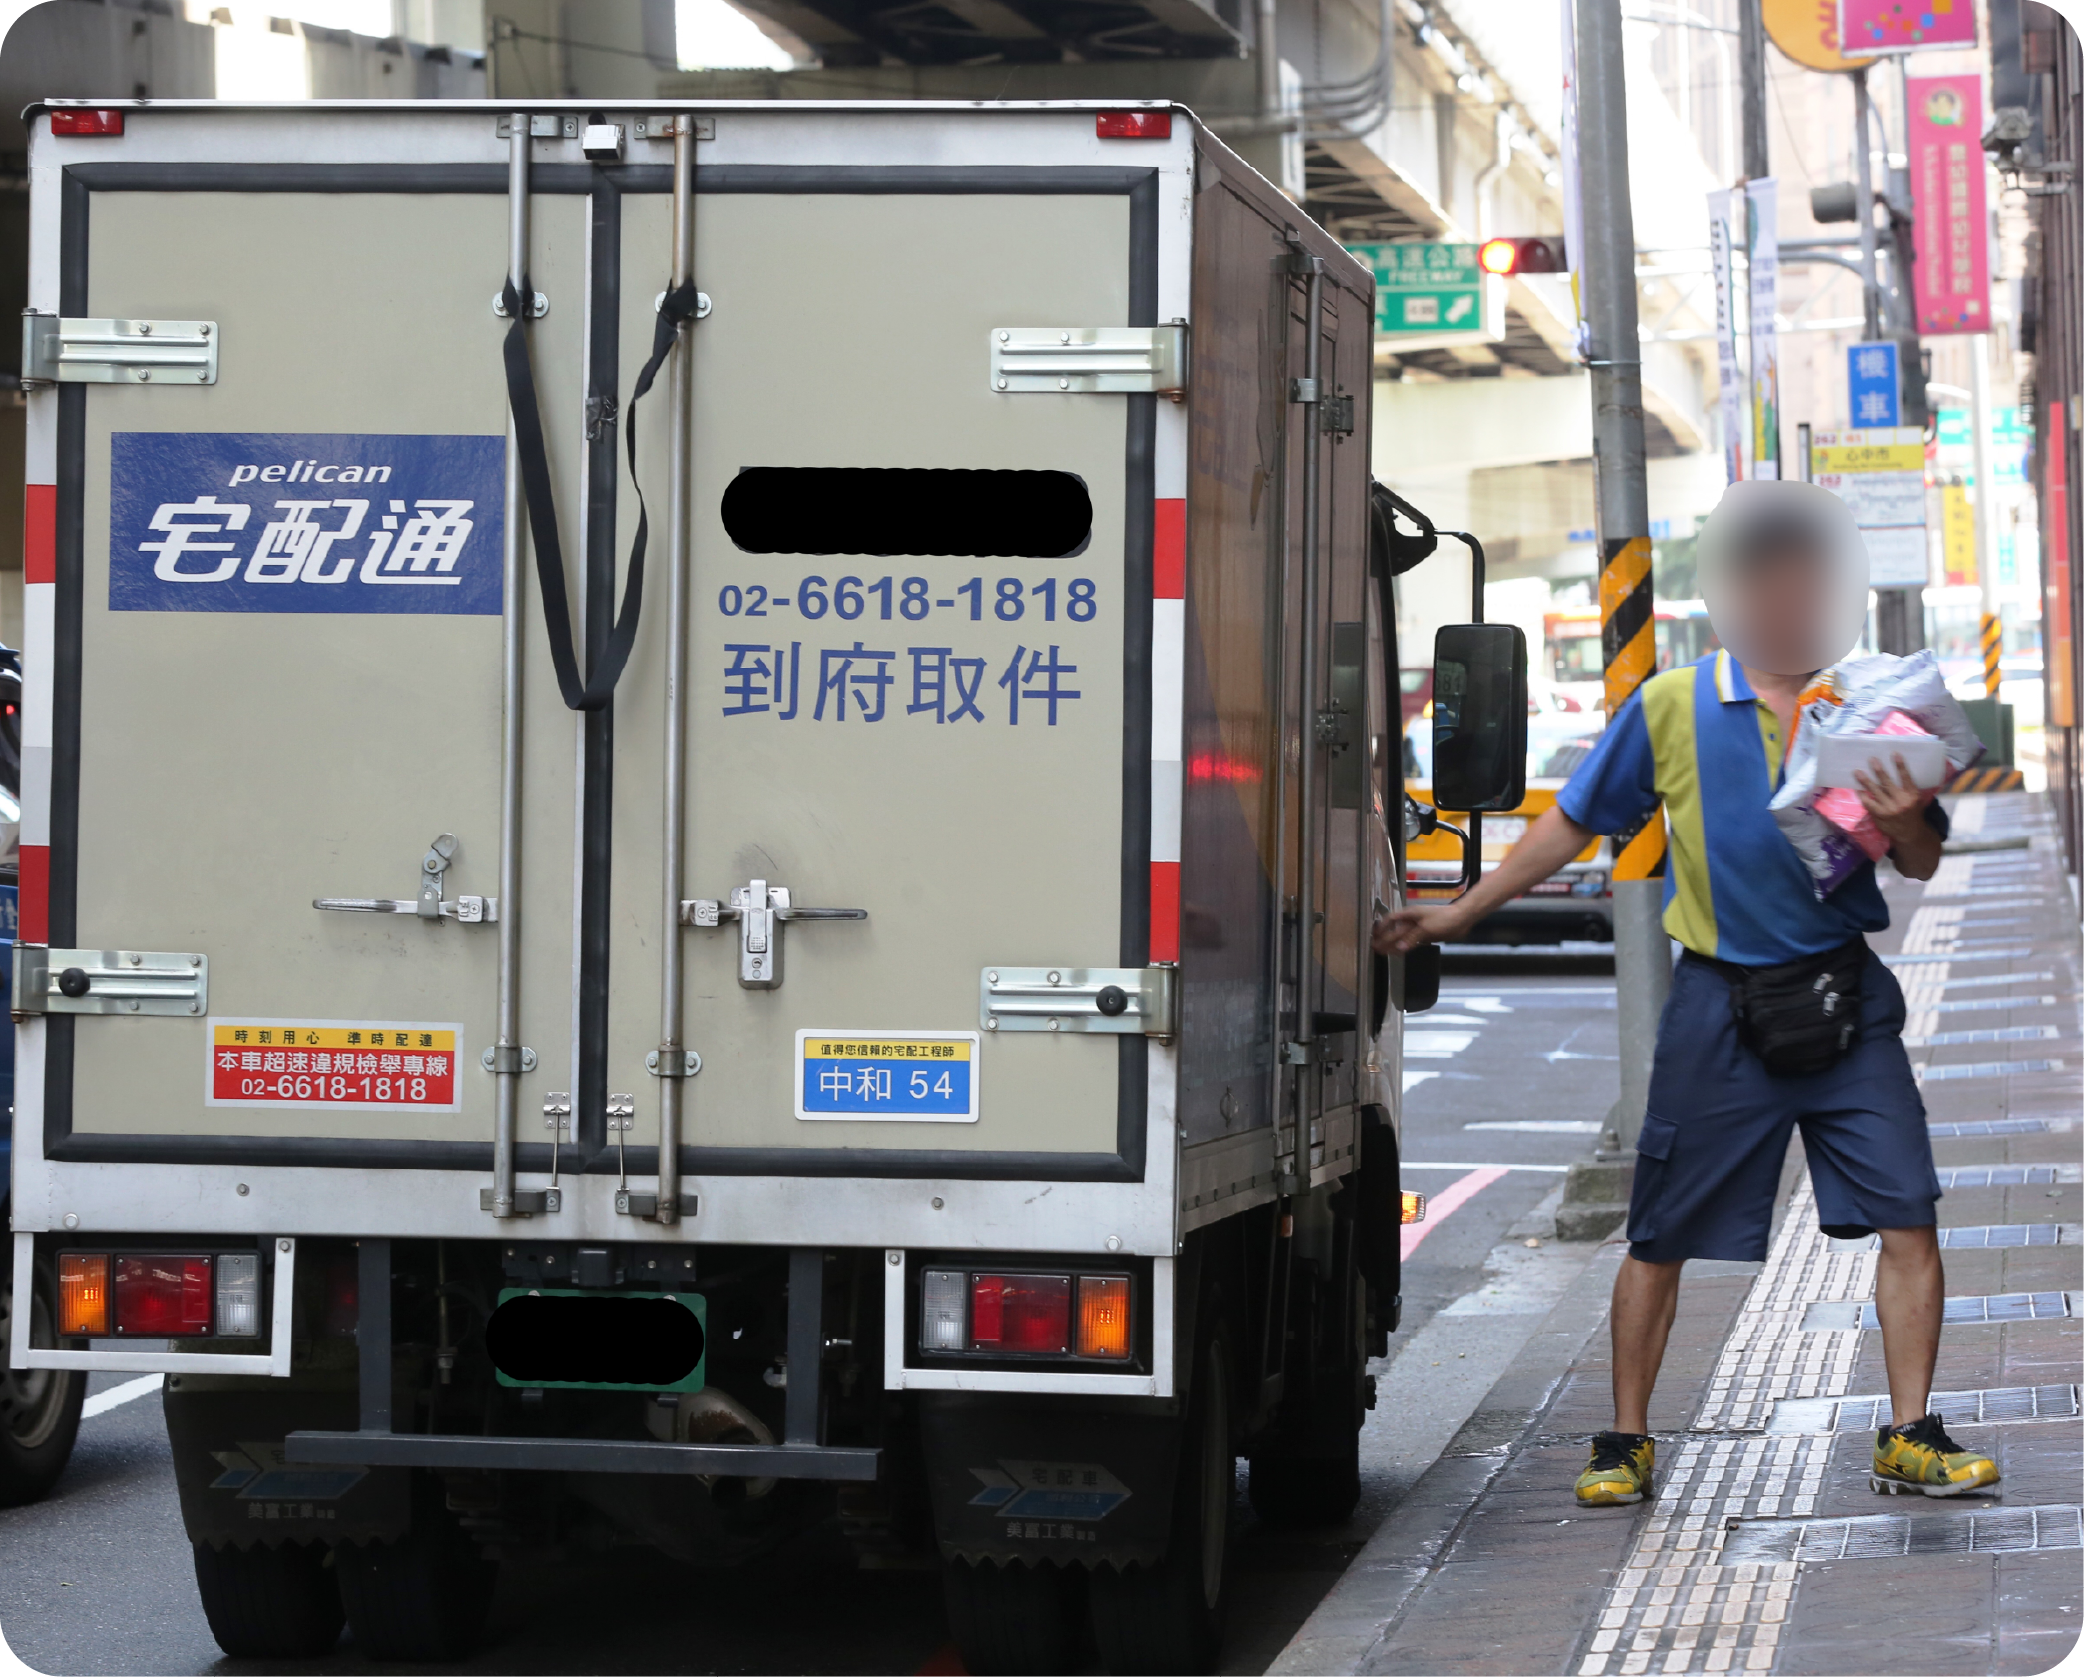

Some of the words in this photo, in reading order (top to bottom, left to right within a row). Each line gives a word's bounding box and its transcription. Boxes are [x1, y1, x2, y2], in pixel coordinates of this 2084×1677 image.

[1375, 244, 1477, 269] 高速公路
[1388, 270, 1463, 283] FREEWAY
[1857, 350, 1891, 423] 機車
[228, 459, 392, 487] pelican
[138, 495, 475, 585] 宅配通
[718, 575, 1097, 623] 02-6618-1818
[722, 641, 1081, 726] 到府取件
[234, 1029, 320, 1045] 時刻用心
[347, 1031, 433, 1047] 準時配達
[821, 1044, 954, 1058] 值得您信賴的宅配工程師
[217, 1051, 448, 1076] 本車超速違規檢舉專線
[241, 1074, 427, 1101] 02-6618-1818
[819, 1065, 891, 1102] 中和
[909, 1070, 953, 1100] 54
[1032, 1467, 1098, 1486] 宅配車
